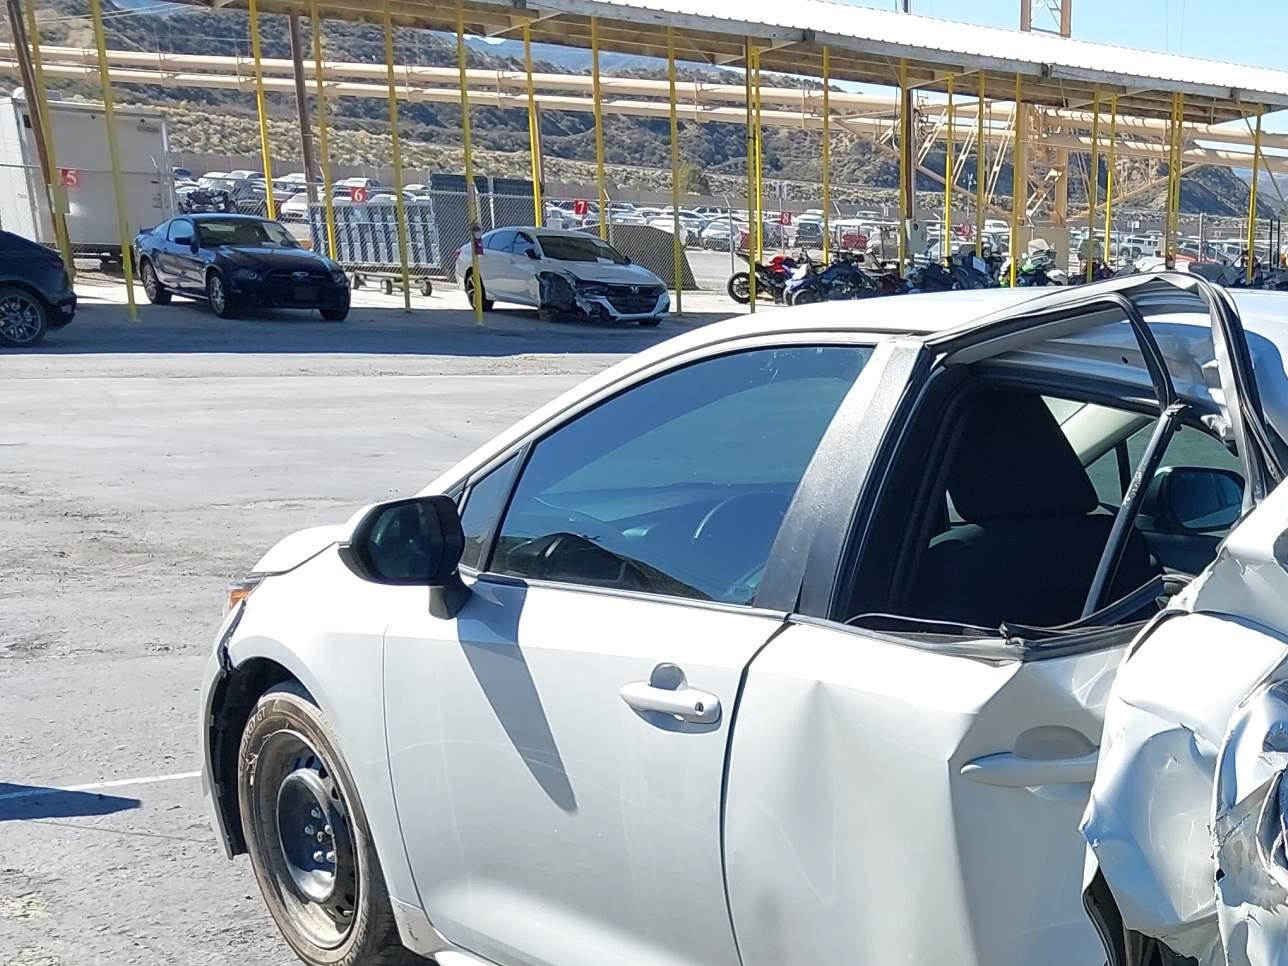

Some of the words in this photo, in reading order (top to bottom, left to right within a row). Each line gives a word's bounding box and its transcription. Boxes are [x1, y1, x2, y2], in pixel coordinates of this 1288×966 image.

[67, 170, 77, 185] 5
[355, 188, 363, 202] 6
[577, 201, 585, 213] 7
[782, 212, 790, 225] 8
[256, 706, 266, 721] GT
